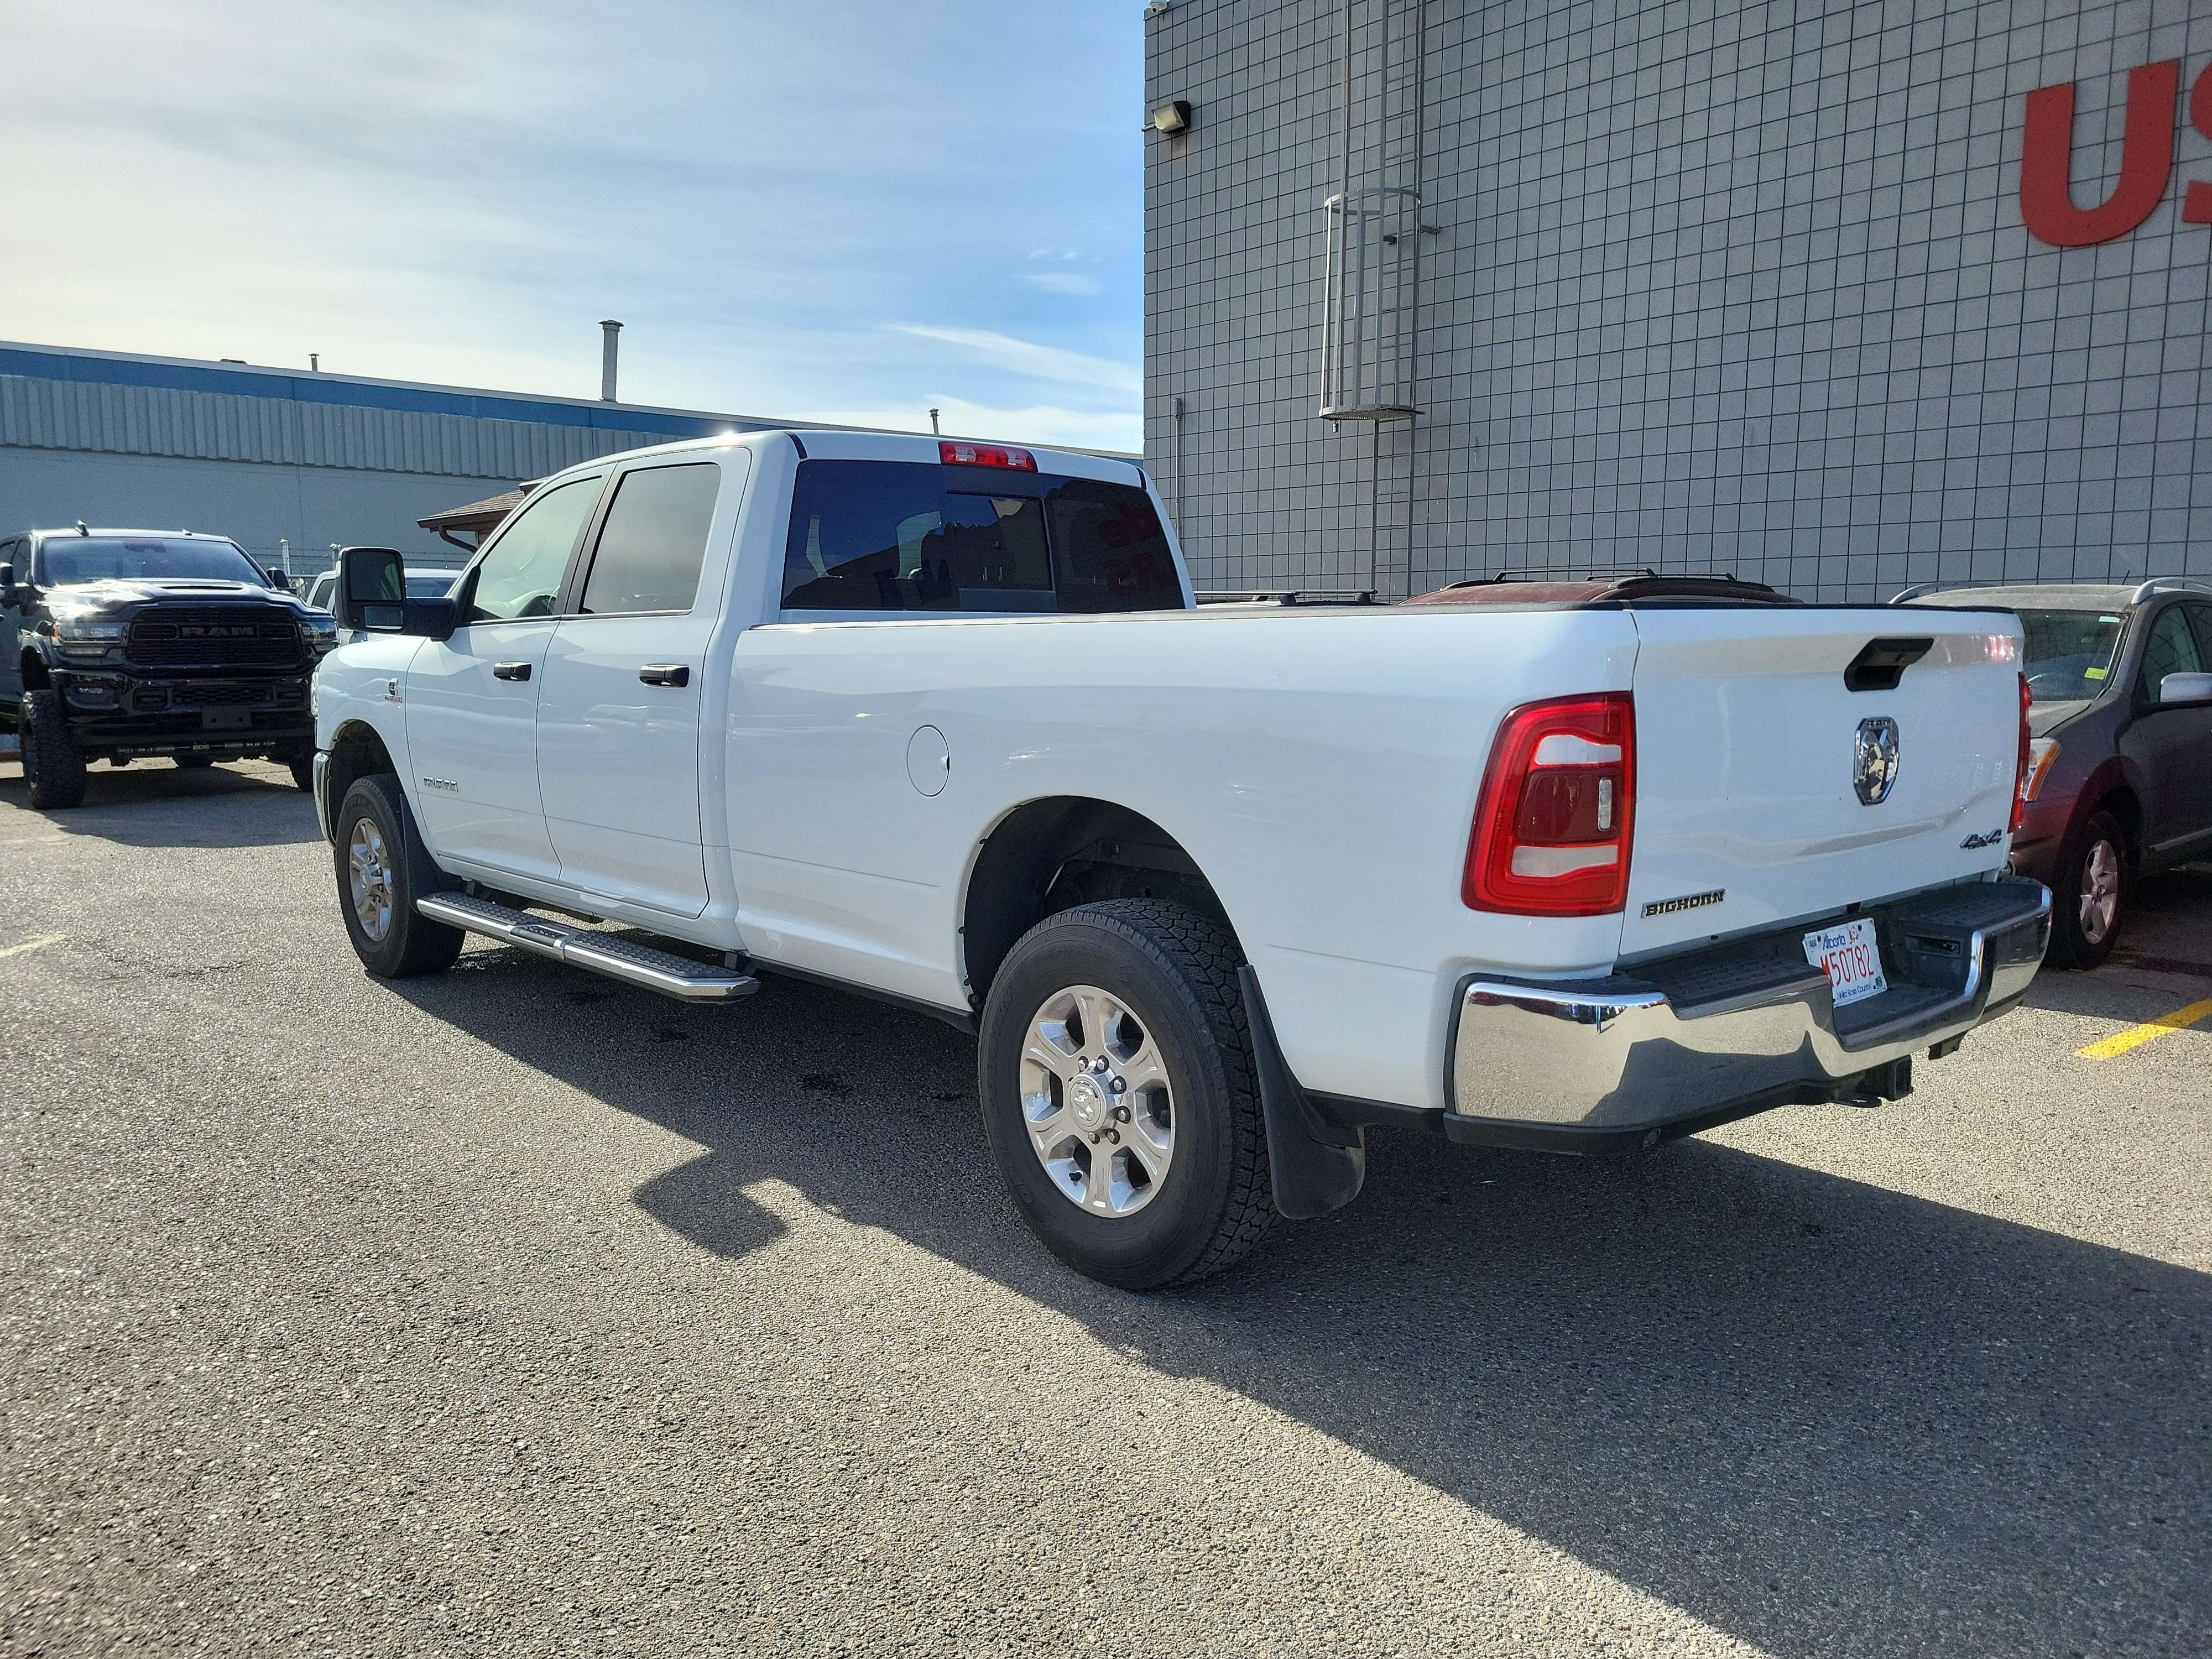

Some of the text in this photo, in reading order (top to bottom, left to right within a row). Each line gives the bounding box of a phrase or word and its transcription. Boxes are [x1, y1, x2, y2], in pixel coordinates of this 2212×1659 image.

[2020, 58, 2212, 247] U
[182, 627, 254, 636] RAM
[1959, 829, 2002, 849] 4x4
[1642, 889, 1726, 917] BIGHORN
[1823, 933, 1846, 951] Alberta
[1820, 943, 1874, 988] M50782
